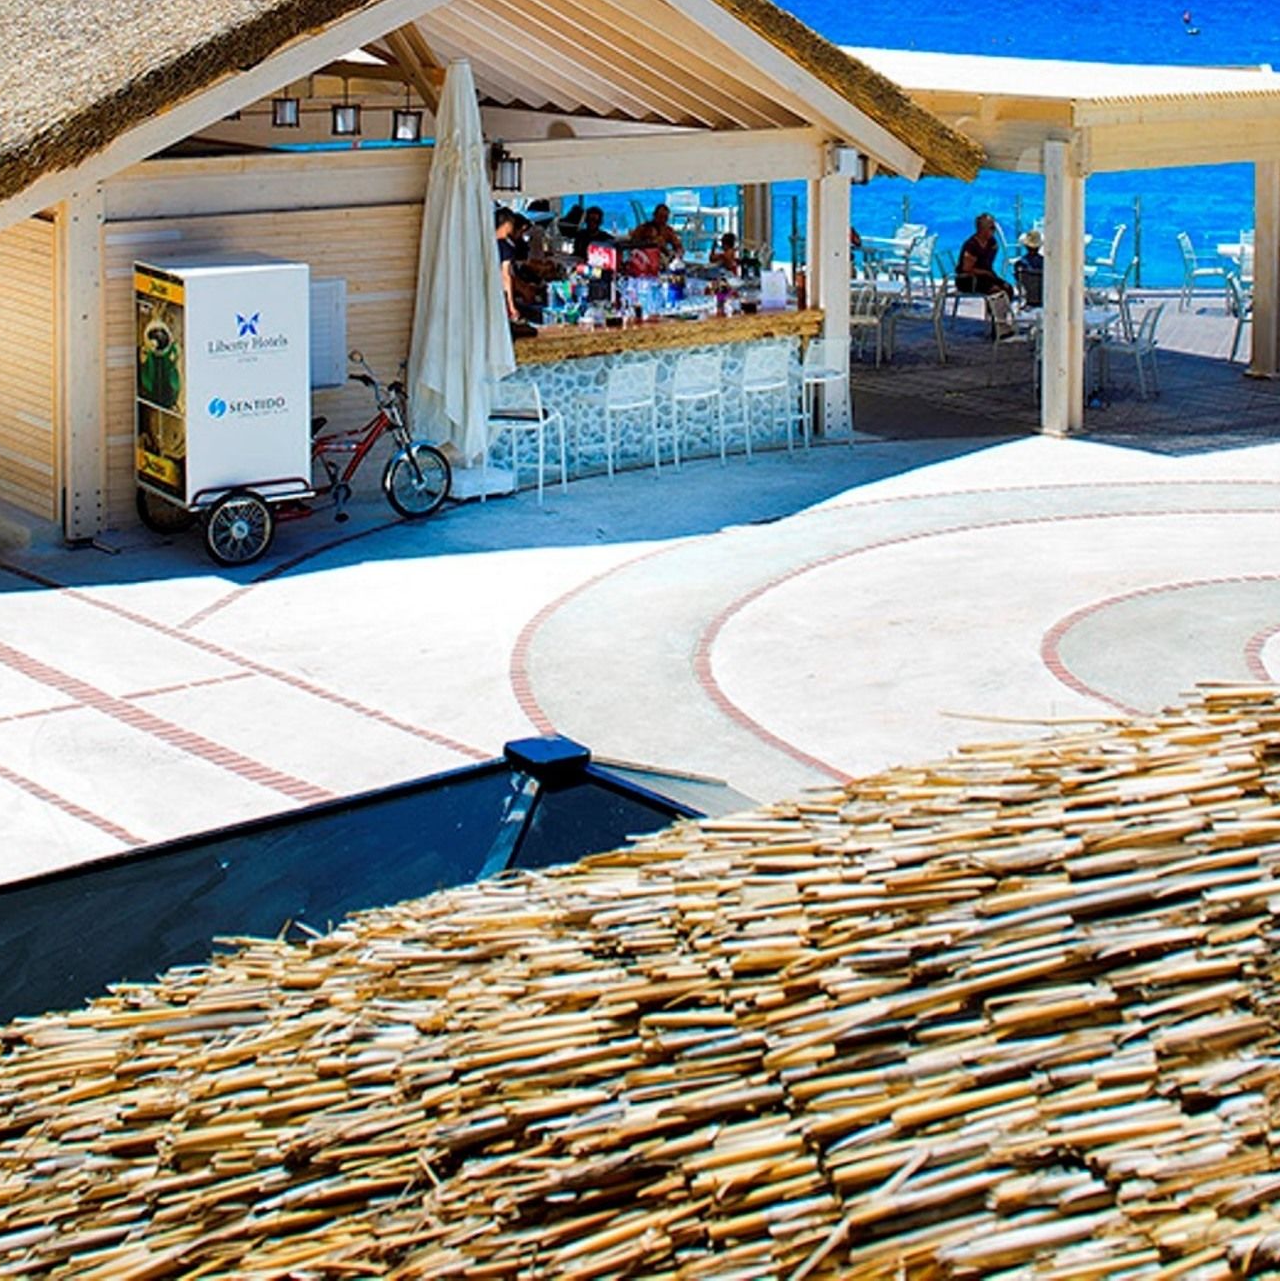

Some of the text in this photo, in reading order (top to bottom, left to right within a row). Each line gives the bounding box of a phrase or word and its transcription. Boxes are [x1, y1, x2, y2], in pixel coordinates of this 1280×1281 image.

[208, 334, 288, 354] Liberty Hotels
[229, 396, 286, 413] SENTIDO
